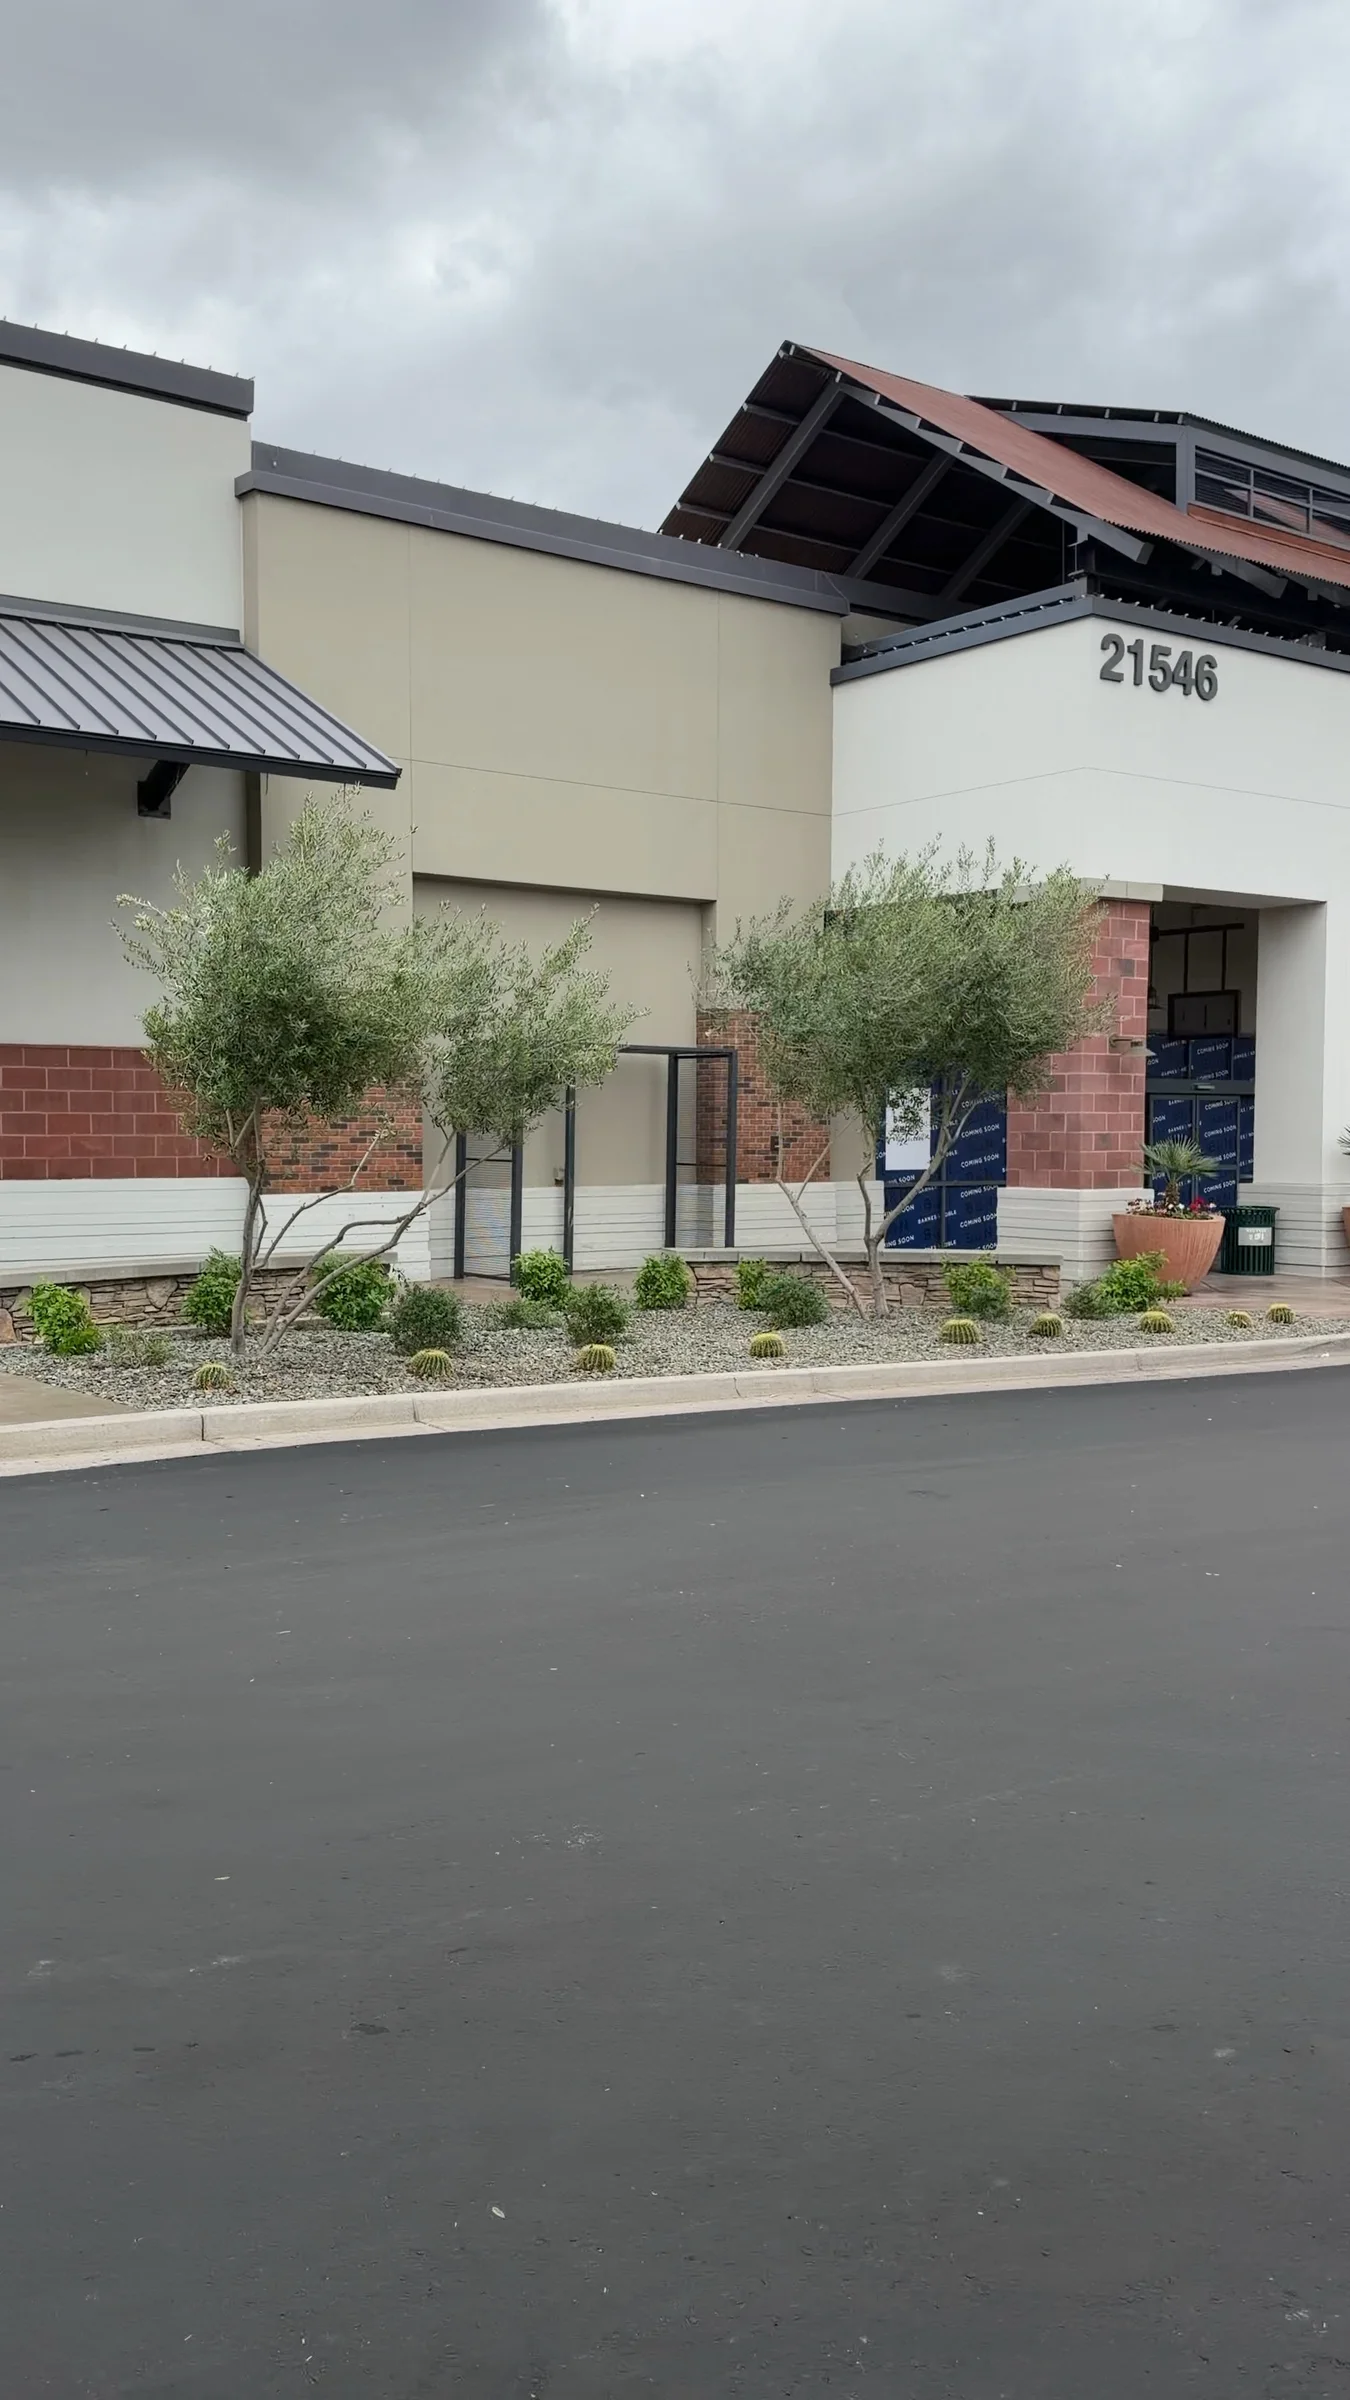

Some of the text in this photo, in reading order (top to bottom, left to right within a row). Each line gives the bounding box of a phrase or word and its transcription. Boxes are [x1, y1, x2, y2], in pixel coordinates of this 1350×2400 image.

[1100, 633, 1218, 701] 21546
[961, 1123, 1000, 1138] COMING SOON
[1204, 1124, 1237, 1138] COMING SOON
[961, 1153, 999, 1168] COMING SOON
[1223, 1152, 1236, 1161] SOON
[960, 1188, 982, 1198] COMING
[1203, 1180, 1236, 1193] COMING SOON
[960, 1217, 982, 1228] COMING
[899, 1235, 914, 1245] SOON
